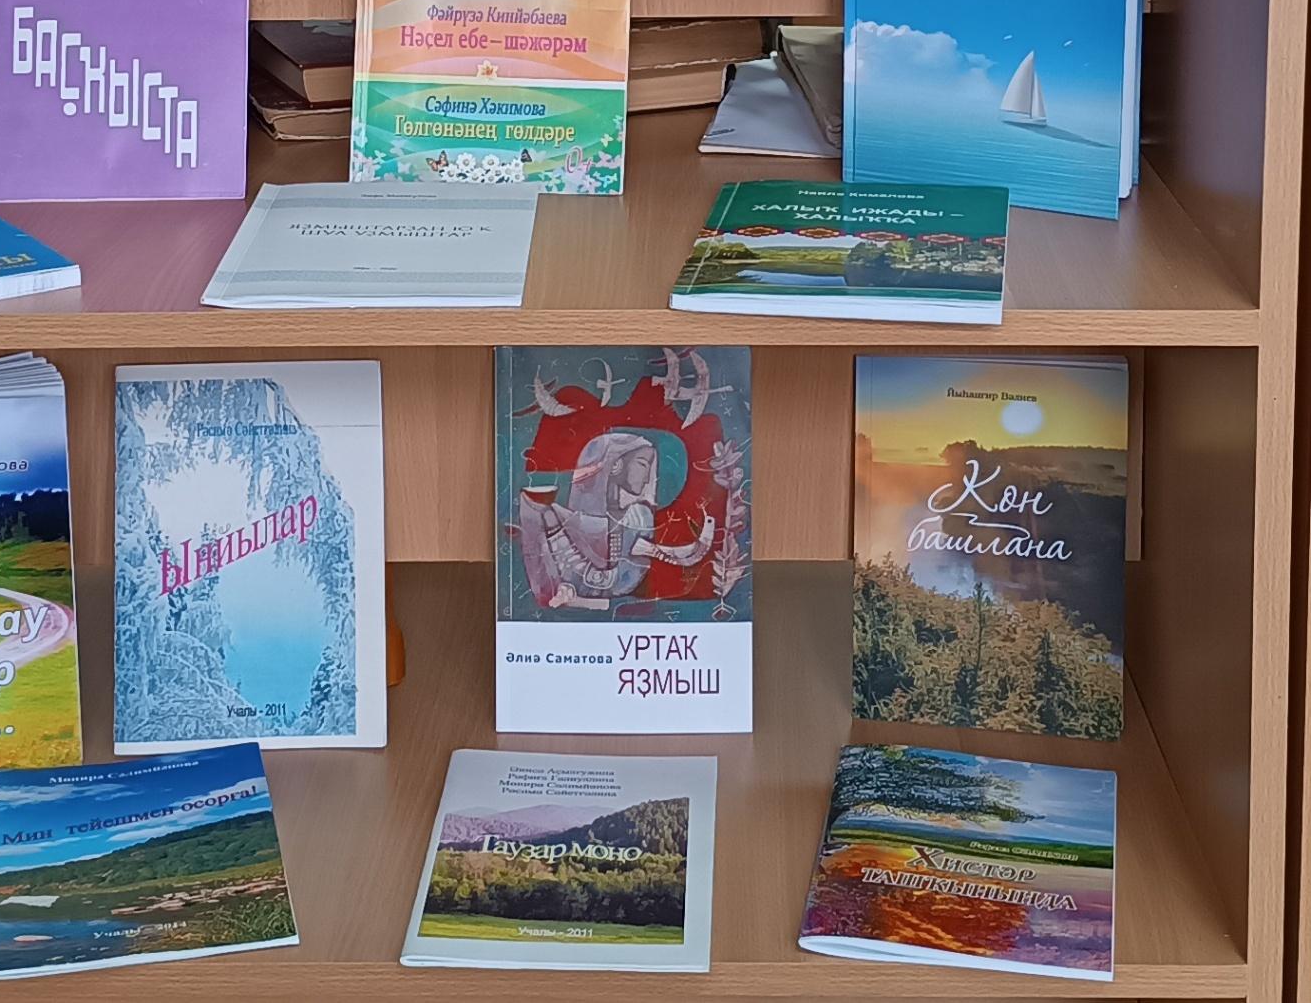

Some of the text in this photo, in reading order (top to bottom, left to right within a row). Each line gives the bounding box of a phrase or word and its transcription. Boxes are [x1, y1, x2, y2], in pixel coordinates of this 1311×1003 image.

[426, 5, 484, 28] Фәйрүзә
[400, 25, 454, 50] Нәҫел
[458, 27, 489, 49] ебе
[504, 35, 588, 58] шәжәрәм
[424, 95, 546, 118] Сәфинә Хәкимова
[504, 123, 576, 147] гөлдәре
[851, 207, 944, 218] ИЖАДЫ
[905, 515, 1073, 561] башлана
[505, 652, 613, 665] Әлиә Саматова
[616, 667, 720, 699] ЯҘМЫШ
[226, 704, 258, 720] Учалы
[265, 703, 287, 718] 2011
[0, 828, 54, 846] Мин
[516, 926, 555, 938] Учалы
[565, 928, 594, 938] 2011
